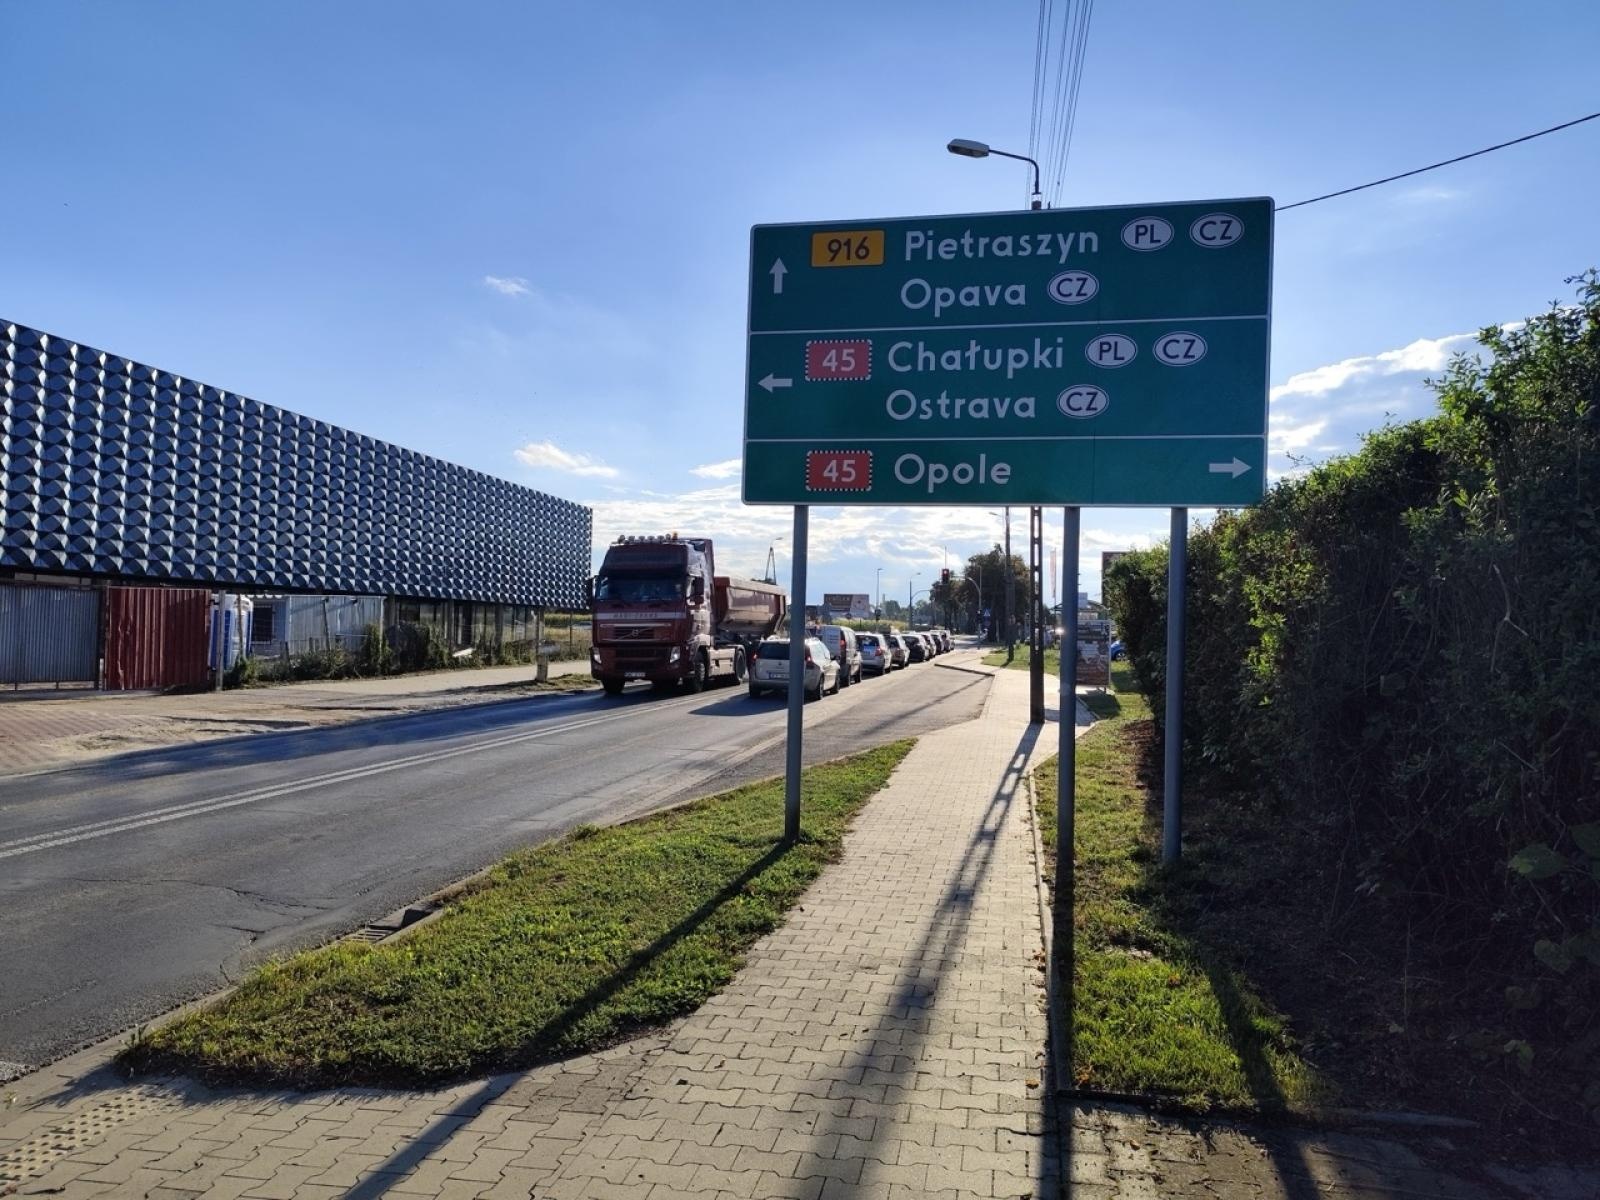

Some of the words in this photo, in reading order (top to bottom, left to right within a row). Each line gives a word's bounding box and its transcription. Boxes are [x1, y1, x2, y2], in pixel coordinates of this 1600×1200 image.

[828, 236, 869, 262] 916
[906, 230, 1098, 264] Pietraszyn
[1135, 224, 1162, 244] PL
[1199, 219, 1235, 242] CZ
[901, 279, 1025, 317] Opava
[1056, 277, 1090, 299] CZ
[822, 349, 855, 372] 45
[888, 337, 1063, 378] Chałupki
[1099, 341, 1126, 362] PL
[1162, 337, 1198, 360] CZ
[887, 390, 1035, 420] Ostrava
[1065, 389, 1099, 412] CZ
[823, 460, 855, 483] 45
[895, 454, 1010, 493] Opole
